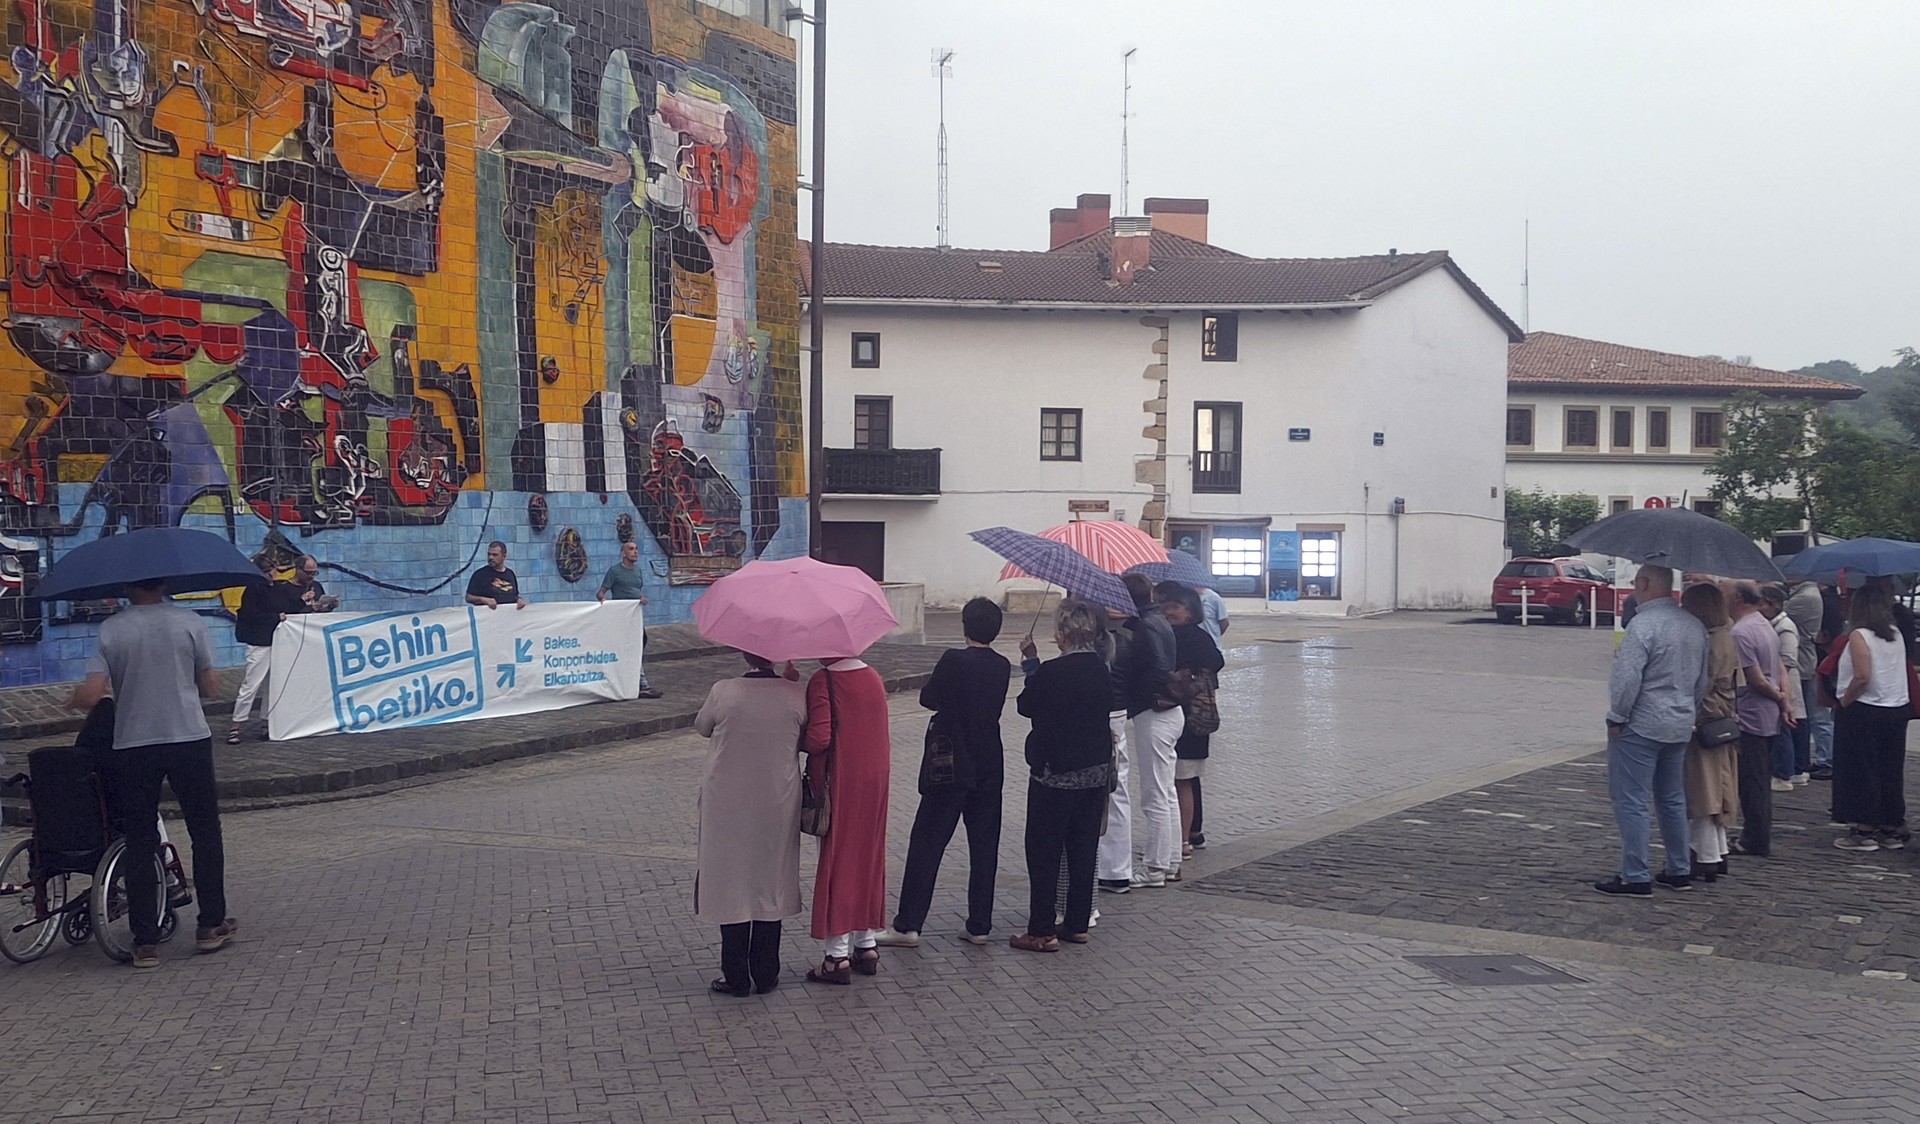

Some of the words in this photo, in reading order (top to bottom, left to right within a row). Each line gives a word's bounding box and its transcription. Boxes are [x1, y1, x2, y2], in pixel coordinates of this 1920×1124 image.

[337, 616, 448, 678] Behin
[543, 635, 581, 651] Bakea.
[543, 650, 619, 670] Konponbidea.
[543, 669, 607, 688] Elkarbizitza.
[346, 674, 475, 731] betiko.
